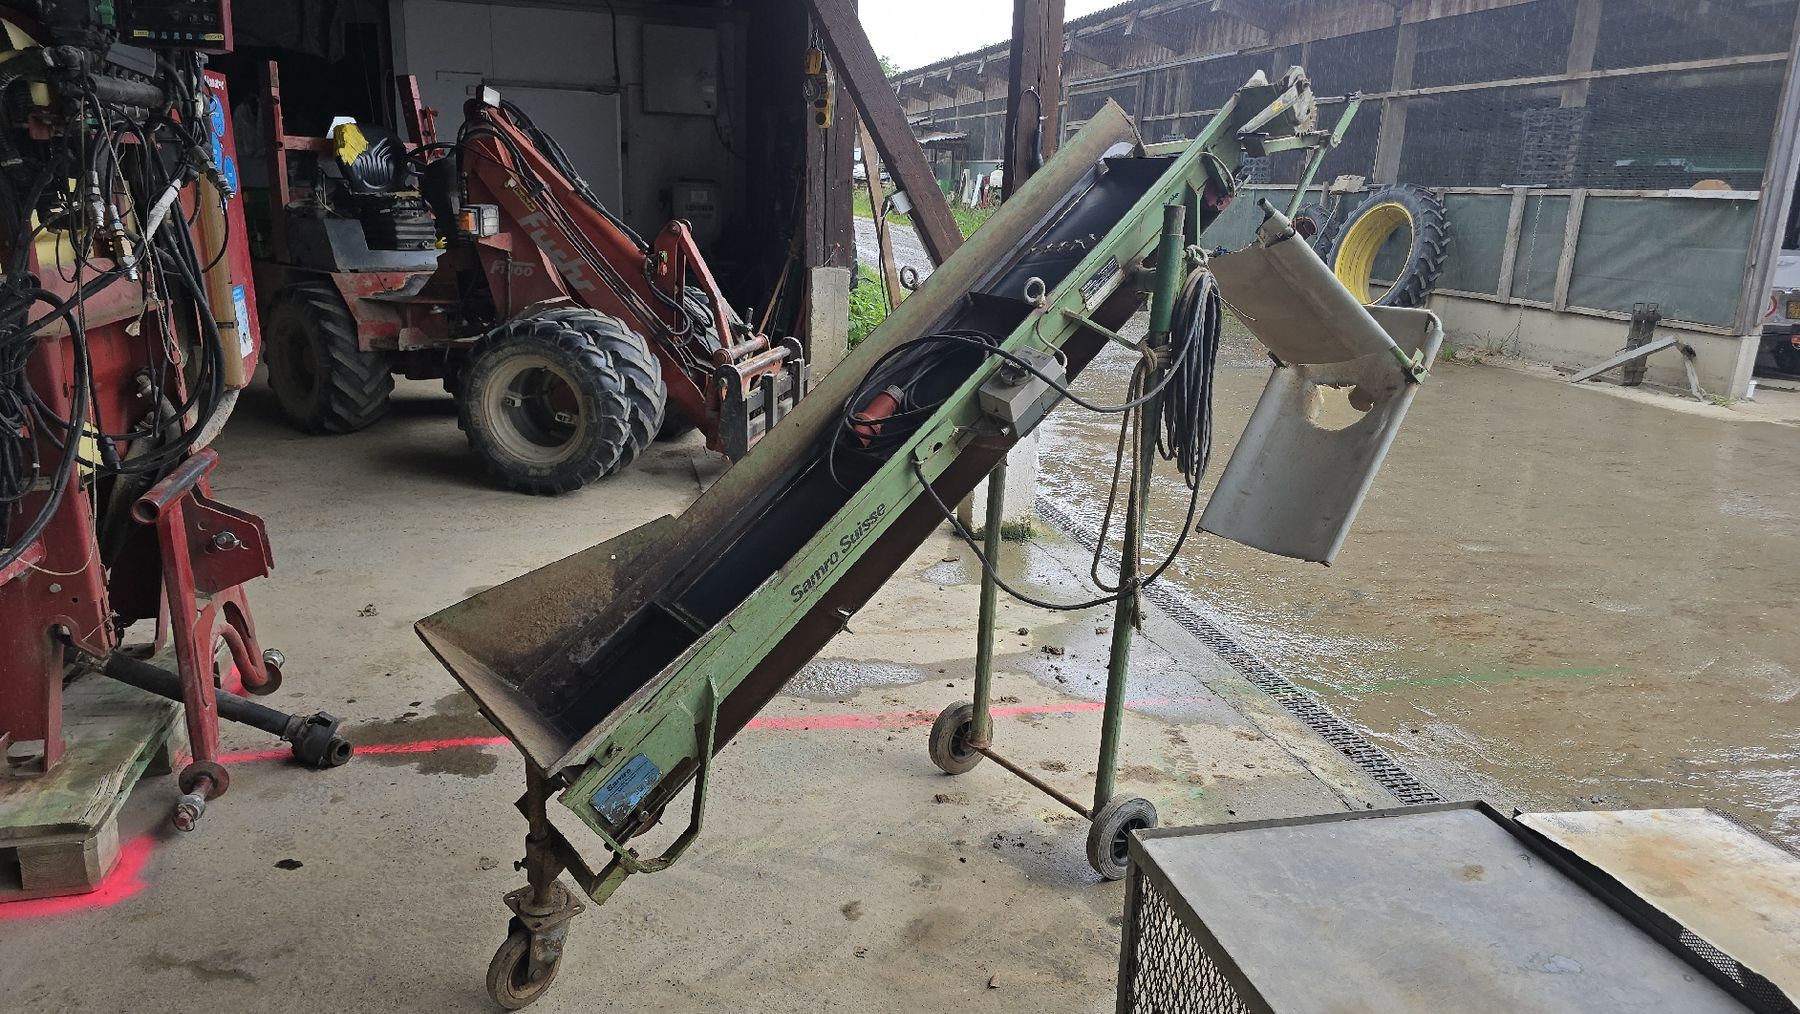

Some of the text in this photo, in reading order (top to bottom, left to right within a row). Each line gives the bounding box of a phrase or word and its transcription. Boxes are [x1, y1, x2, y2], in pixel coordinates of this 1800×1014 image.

[517, 211, 597, 291] Fuchs
[791, 503, 885, 603] Samro Suisse
